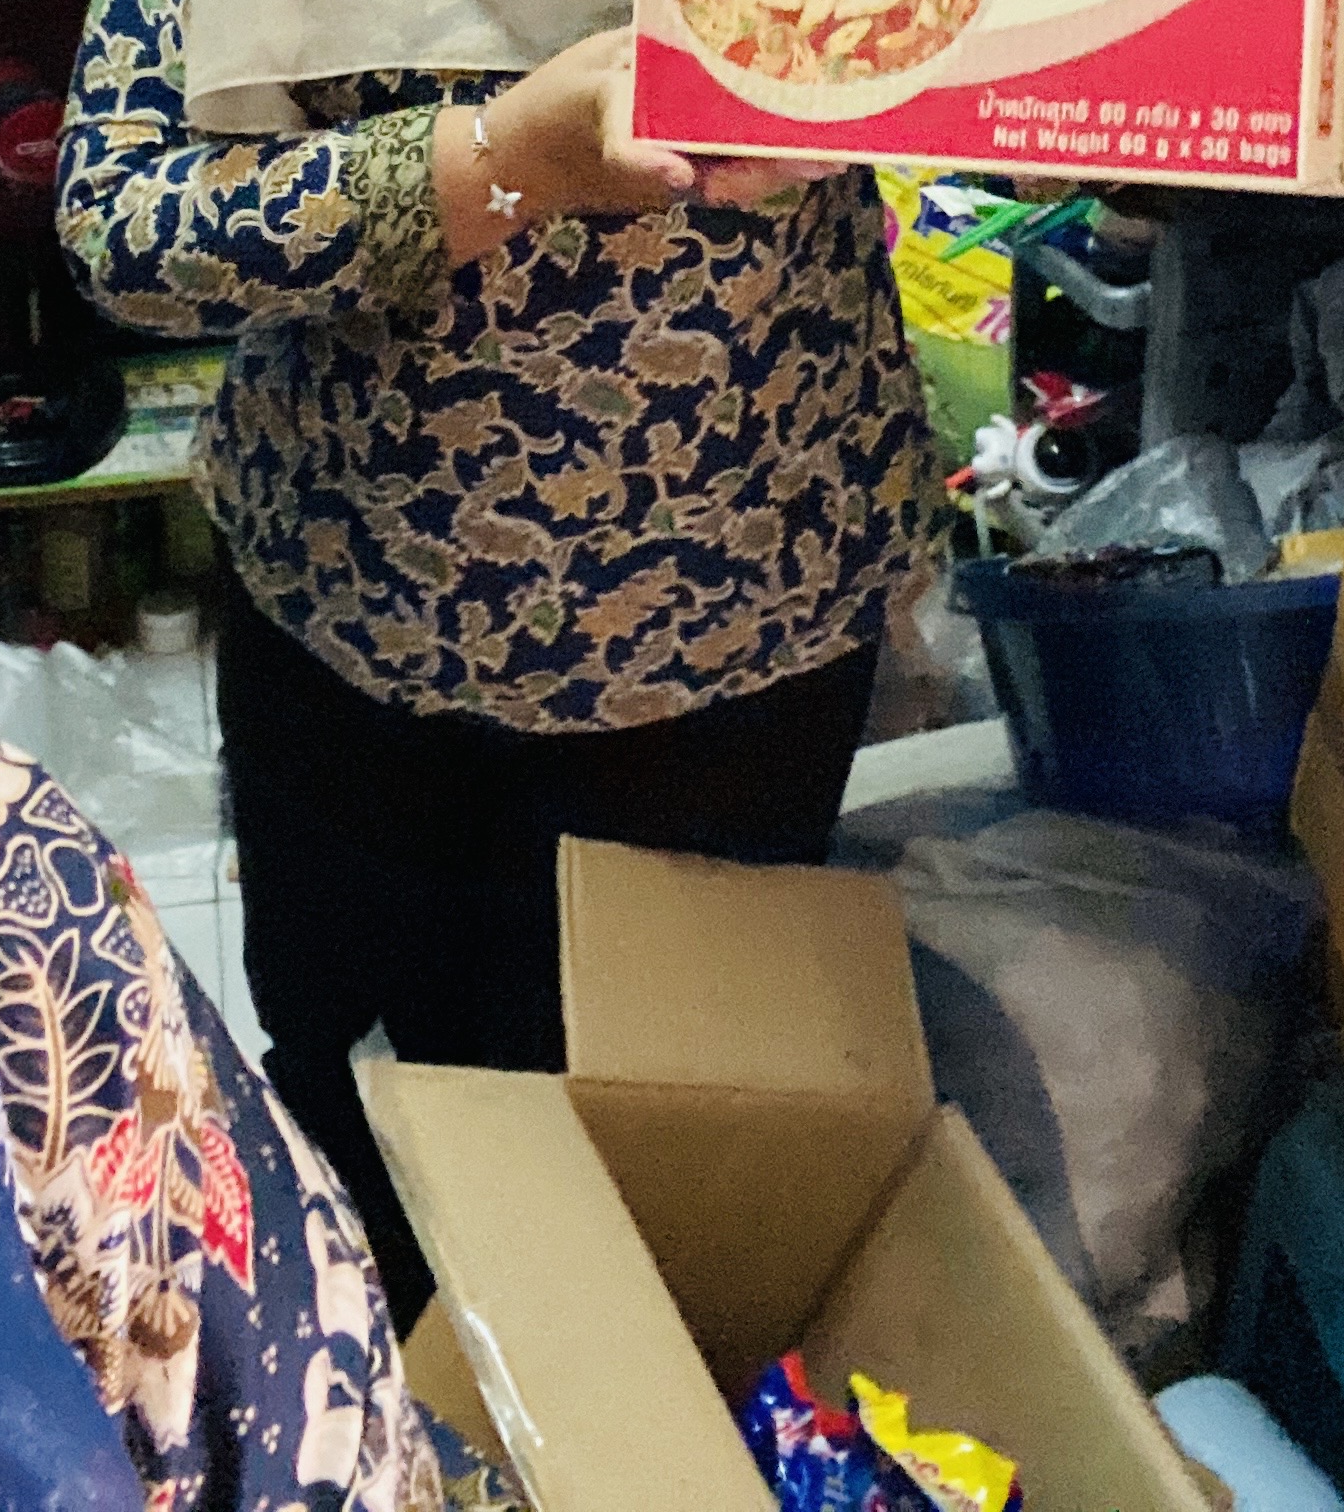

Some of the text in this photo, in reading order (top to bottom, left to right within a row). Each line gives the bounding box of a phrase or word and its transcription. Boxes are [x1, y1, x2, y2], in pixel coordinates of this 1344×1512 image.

[1099, 101, 1126, 127] 60
[1211, 106, 1239, 132] 30
[994, 124, 1027, 149] Net
[1038, 127, 1110, 156] Weight
[1120, 132, 1147, 156] 60
[1201, 136, 1230, 161] 30
[1240, 139, 1291, 169] bags
